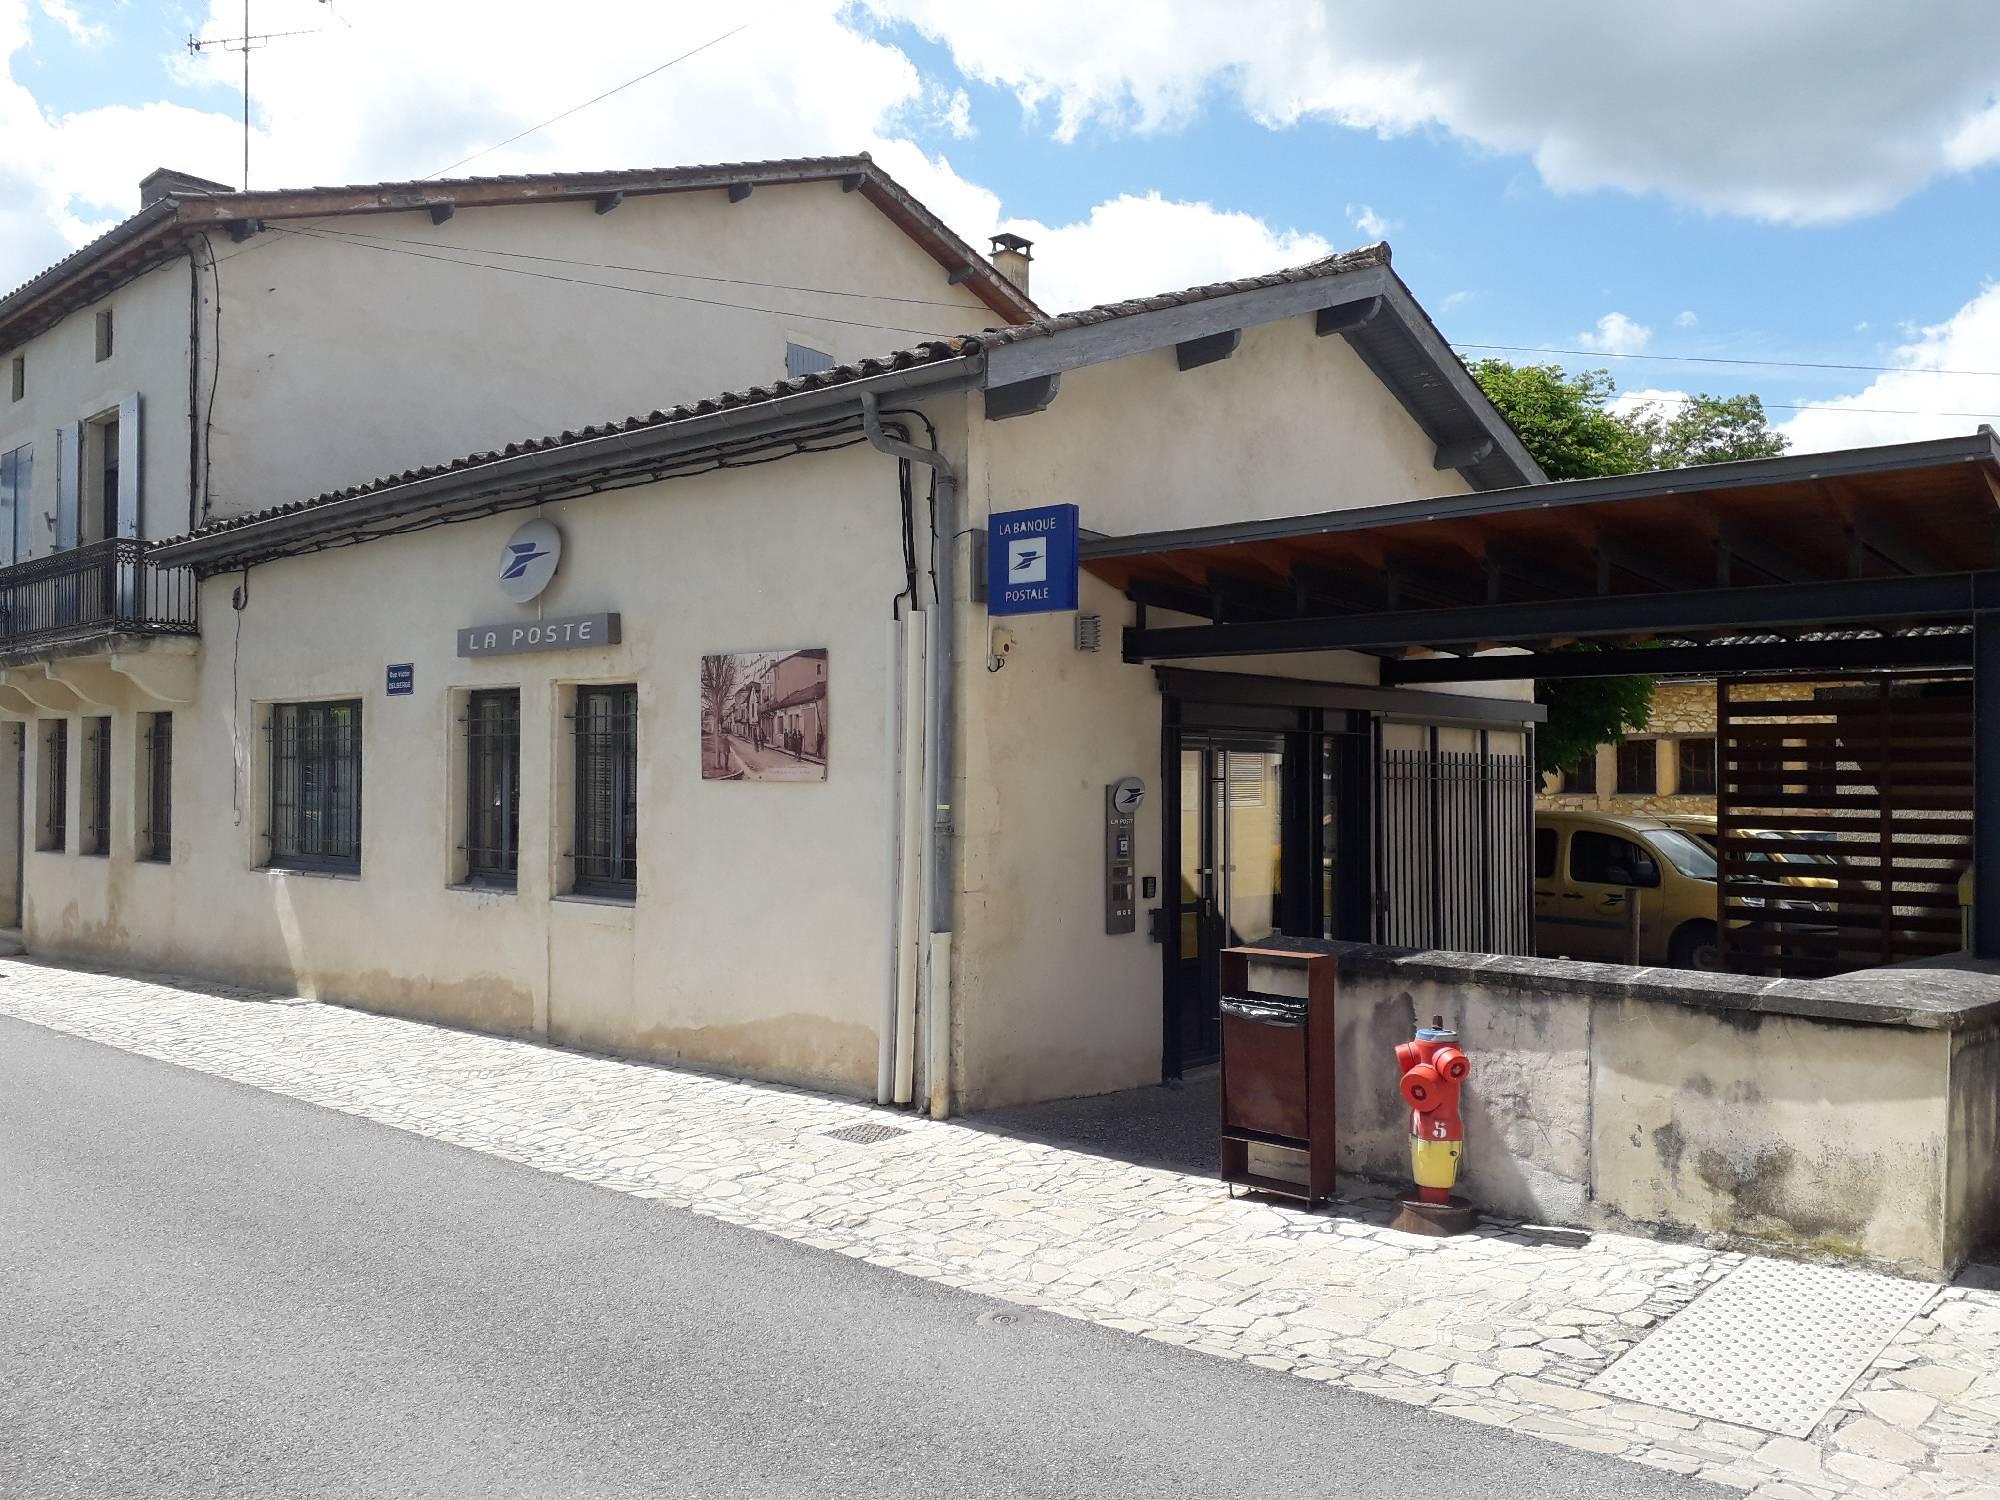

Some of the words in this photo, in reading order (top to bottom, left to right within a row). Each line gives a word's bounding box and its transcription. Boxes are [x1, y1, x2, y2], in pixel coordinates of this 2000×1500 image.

[999, 523, 1011, 536] LA
[1013, 517, 1057, 534] BANQUE
[1005, 587, 1049, 603] POSTALE
[469, 632, 497, 650] LA
[511, 621, 593, 646] POSTE
[1432, 1120, 1447, 1138] 5
